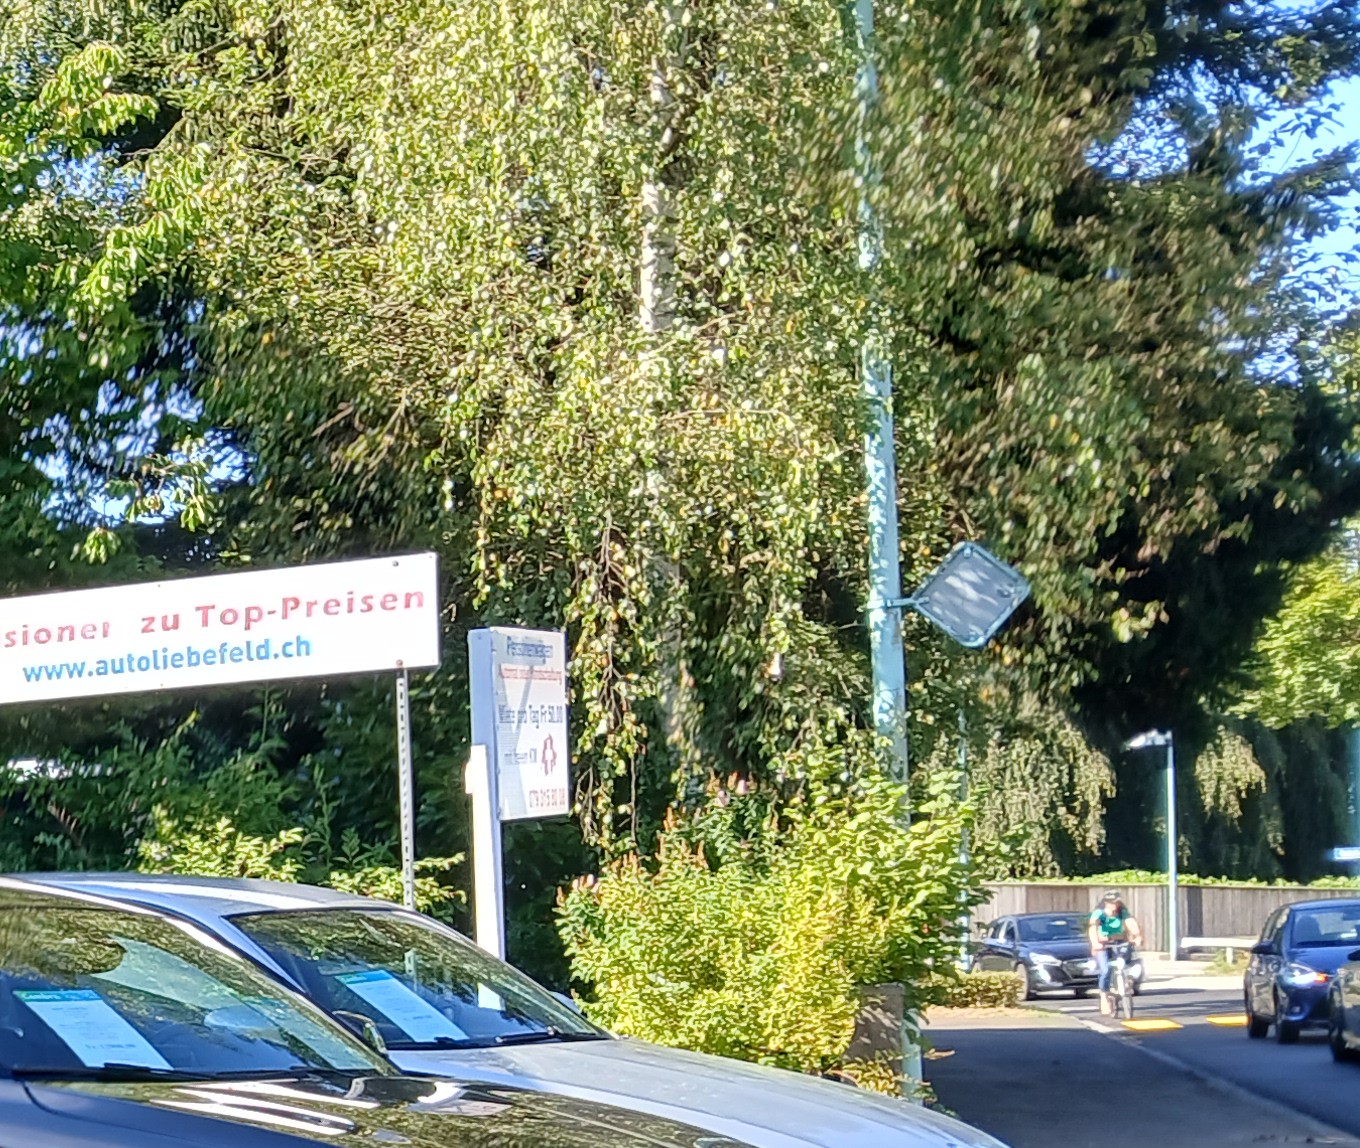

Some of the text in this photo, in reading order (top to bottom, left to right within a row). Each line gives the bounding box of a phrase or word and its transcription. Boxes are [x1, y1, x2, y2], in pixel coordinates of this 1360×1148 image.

[141, 614, 179, 633] zu
[195, 591, 424, 631] Top-Preisen
[23, 635, 311, 682] www.autoliebefeld.ch
